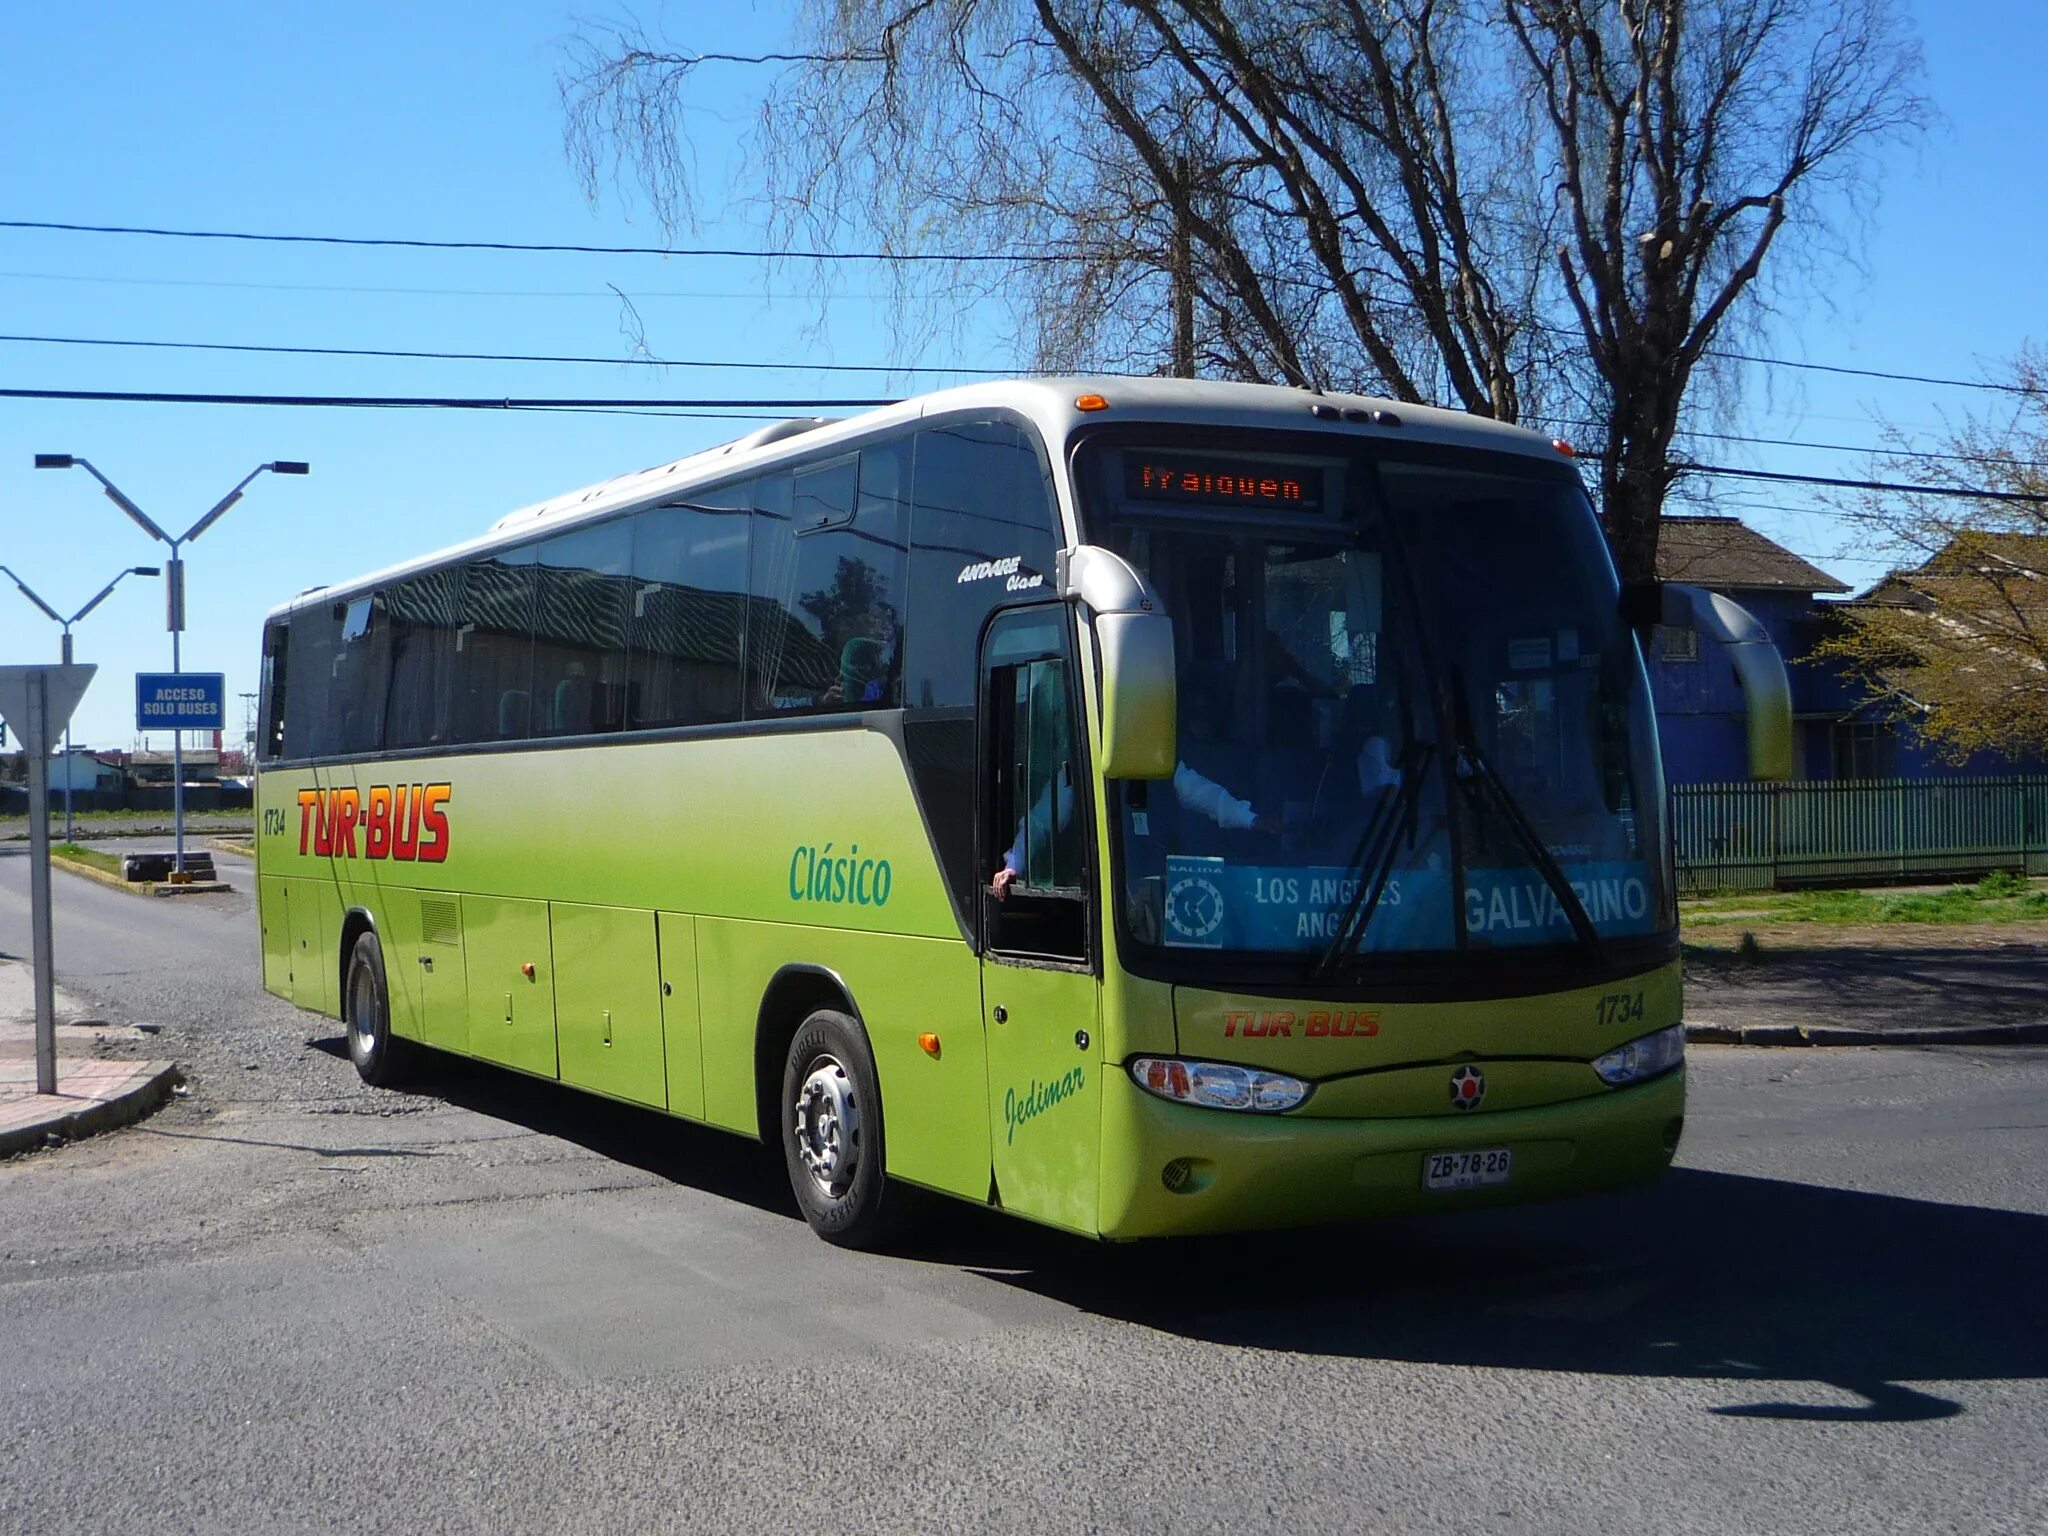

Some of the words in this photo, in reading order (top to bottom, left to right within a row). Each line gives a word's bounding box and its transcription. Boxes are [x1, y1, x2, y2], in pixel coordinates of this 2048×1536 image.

[958, 556, 1021, 583] ANDARE
[144, 702, 174, 715] SOLO
[178, 702, 218, 715] BUSES
[156, 688, 205, 701] ACCESO
[264, 809, 286, 836] 1734
[298, 782, 452, 863] TUR-BUS
[790, 842, 892, 907] Clásico
[1168, 864, 1223, 874] SALIDA
[1255, 877, 1299, 904] LOS
[1308, 878, 1401, 906] ANGS
[1464, 878, 1646, 932] GALVARINO
[1296, 911, 1367, 938] ANG
[1596, 992, 1644, 1025] 1734
[1005, 1066, 1086, 1146] Jedimar
